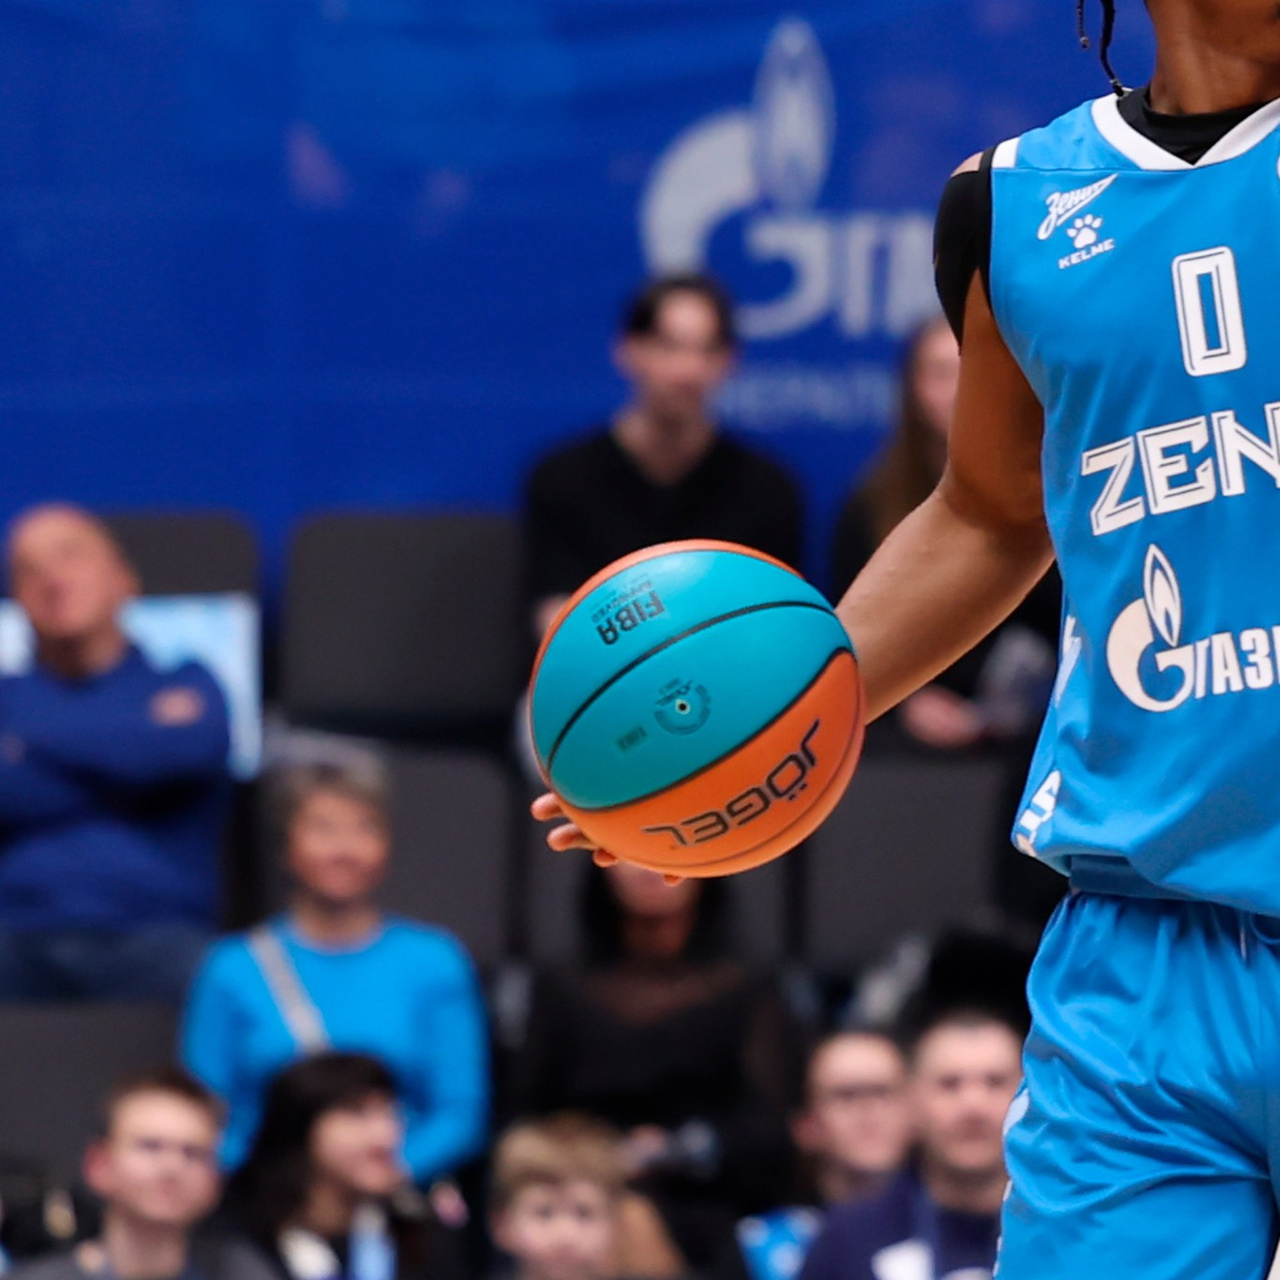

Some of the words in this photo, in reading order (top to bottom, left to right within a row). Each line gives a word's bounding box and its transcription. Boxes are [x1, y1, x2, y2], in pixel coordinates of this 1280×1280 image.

[1058, 238, 1115, 270] KELME
[1171, 245, 1248, 377] 0
[597, 590, 665, 645] FIBA
[644, 718, 820, 845] JÖGEL
